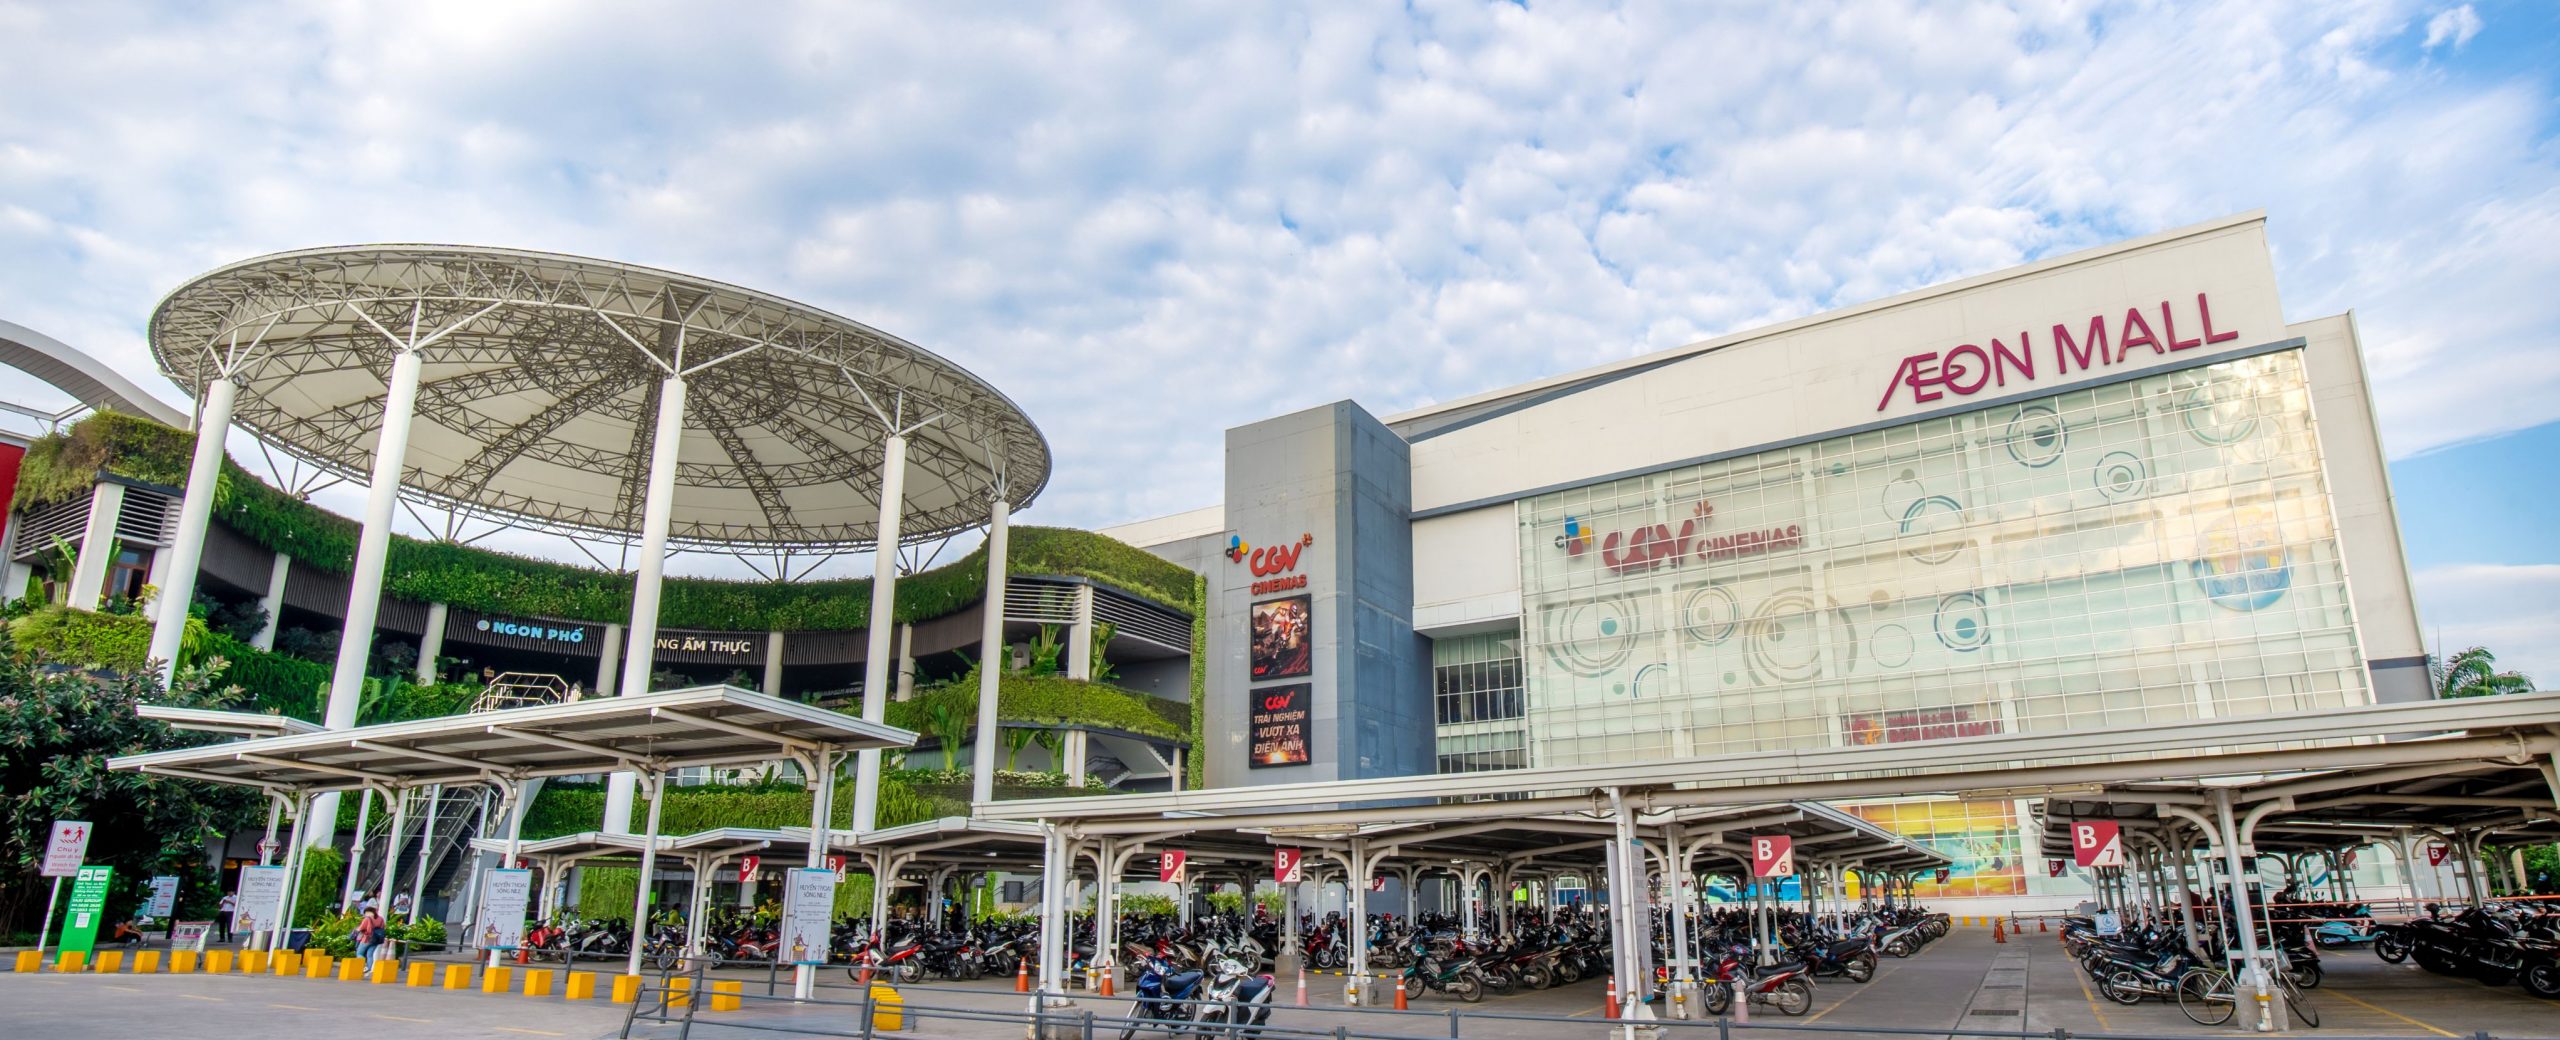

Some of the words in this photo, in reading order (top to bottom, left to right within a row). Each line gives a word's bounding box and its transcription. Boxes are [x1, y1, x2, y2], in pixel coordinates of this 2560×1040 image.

[2053, 293, 2239, 375] MALL
[1697, 525, 1803, 560] CINEMAS
[1250, 542, 1302, 577] CGV
[1251, 575, 1307, 595] CINEMAS
[492, 621, 543, 638] NGON
[547, 627, 584, 643] PHỐ
[710, 640, 751, 655] THỰC
[1265, 695, 1290, 710] CGV
[1287, 724, 1300, 736] XA
[2077, 825, 2097, 849] B
[1757, 839, 1773, 861] B
[2106, 849, 2115, 862] 7
[2430, 849, 2440, 859] B
[743, 858, 751, 872] B
[829, 858, 836, 872] B
[1164, 853, 1174, 870] B
[1278, 851, 1288, 869] B
[1779, 861, 1788, 873] 6
[2051, 861, 2058, 871] B
[750, 872, 755, 880] 2
[838, 873, 843, 881] 3
[1176, 870, 1182, 880] 4
[1291, 870, 1297, 880] 5
